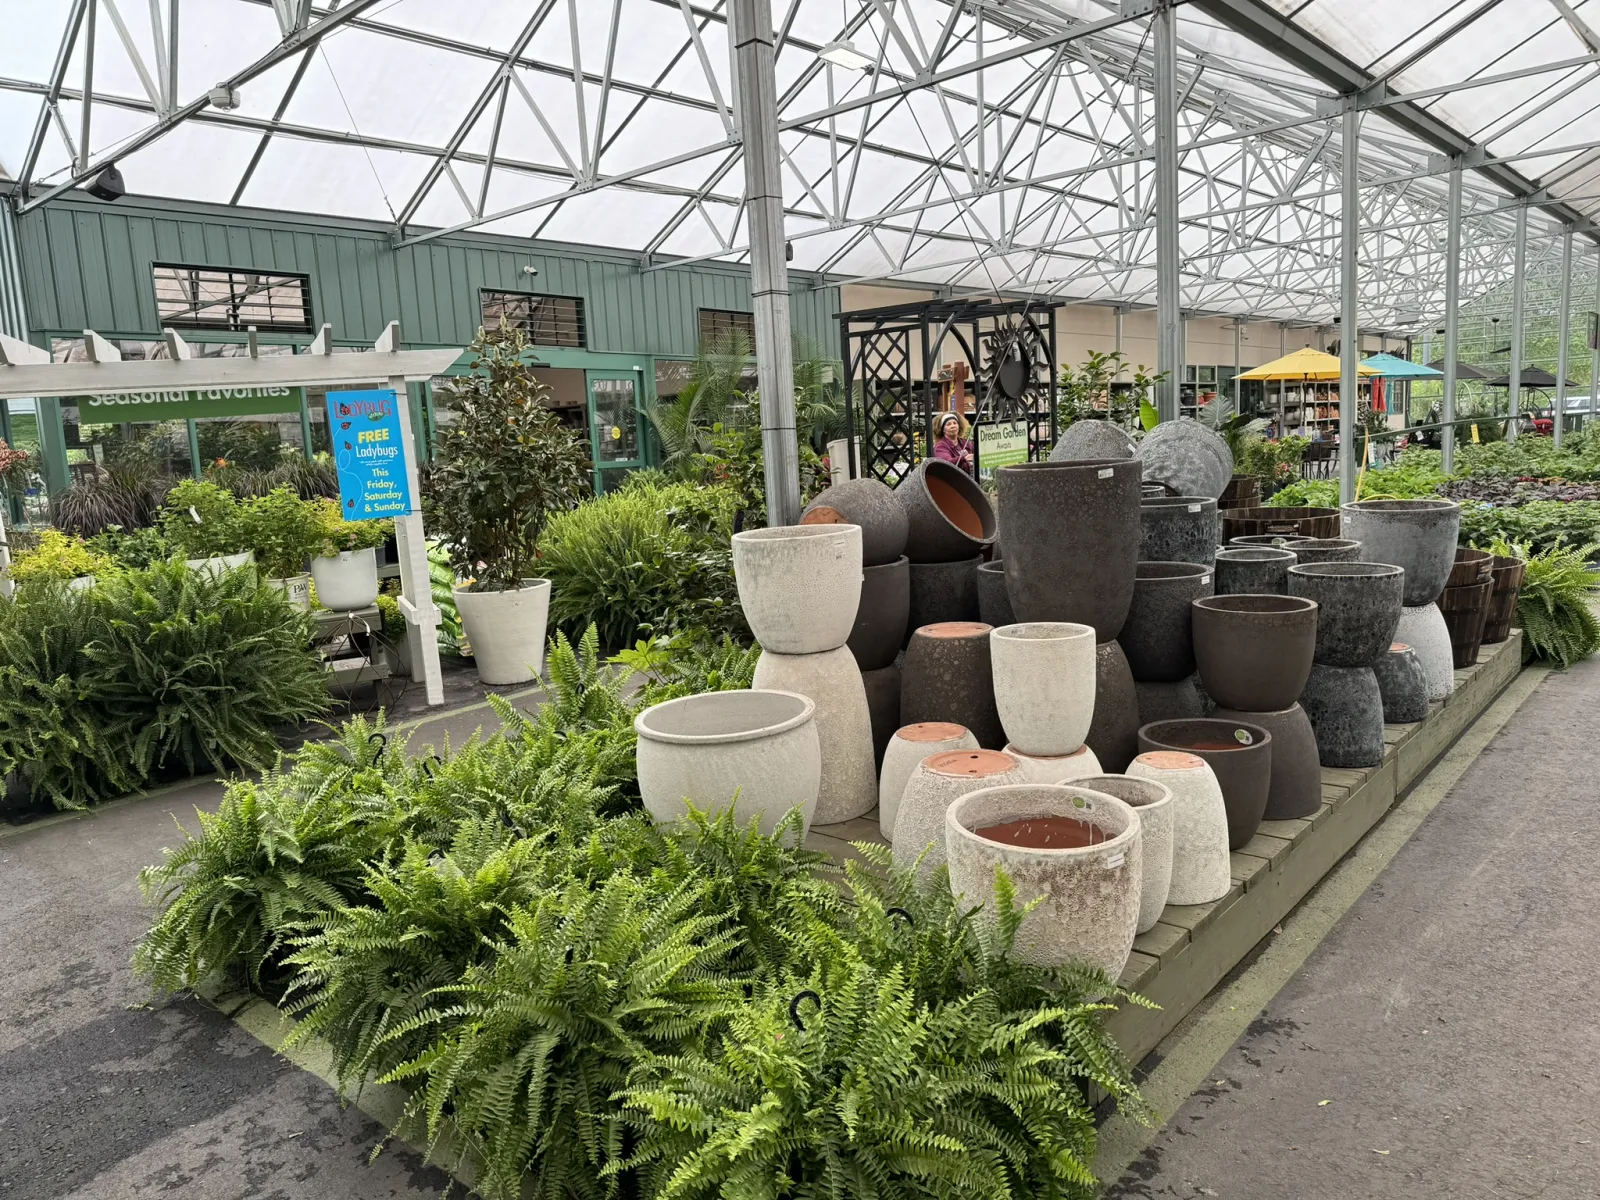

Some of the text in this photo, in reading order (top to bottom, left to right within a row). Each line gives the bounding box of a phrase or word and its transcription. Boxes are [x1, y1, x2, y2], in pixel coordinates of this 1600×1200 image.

[88, 391, 190, 407] Seasonal
[357, 428, 390, 443] FREE
[980, 424, 1026, 442] Dream Garden
[355, 443, 398, 459] Ladybugs
[371, 468, 389, 477] This
[366, 479, 397, 489] Friday,
[364, 490, 402, 501] Saturday
[364, 501, 405, 512] & Sunday
